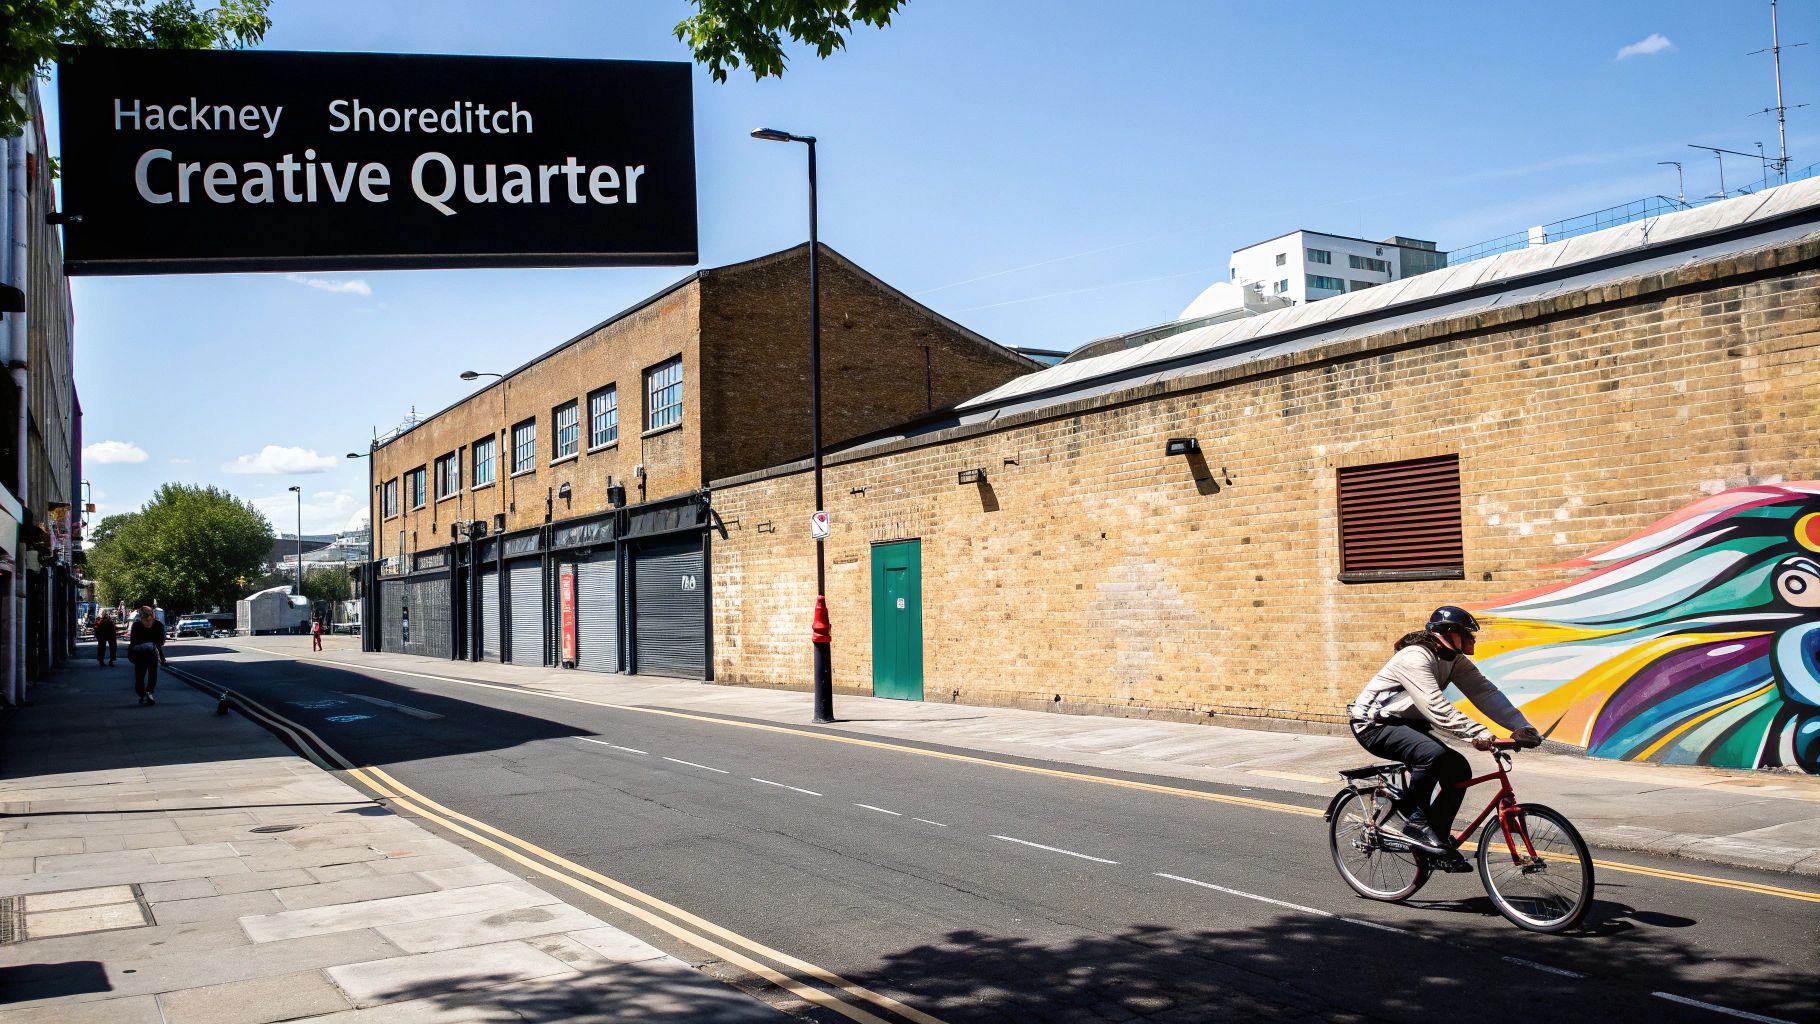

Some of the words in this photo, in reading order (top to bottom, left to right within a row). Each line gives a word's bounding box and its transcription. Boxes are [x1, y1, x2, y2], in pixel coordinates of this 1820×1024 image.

[115, 97, 284, 139] Hackney
[328, 98, 534, 134] Shoreditch
[134, 148, 391, 204] Creative
[410, 151, 645, 217] Quarter
